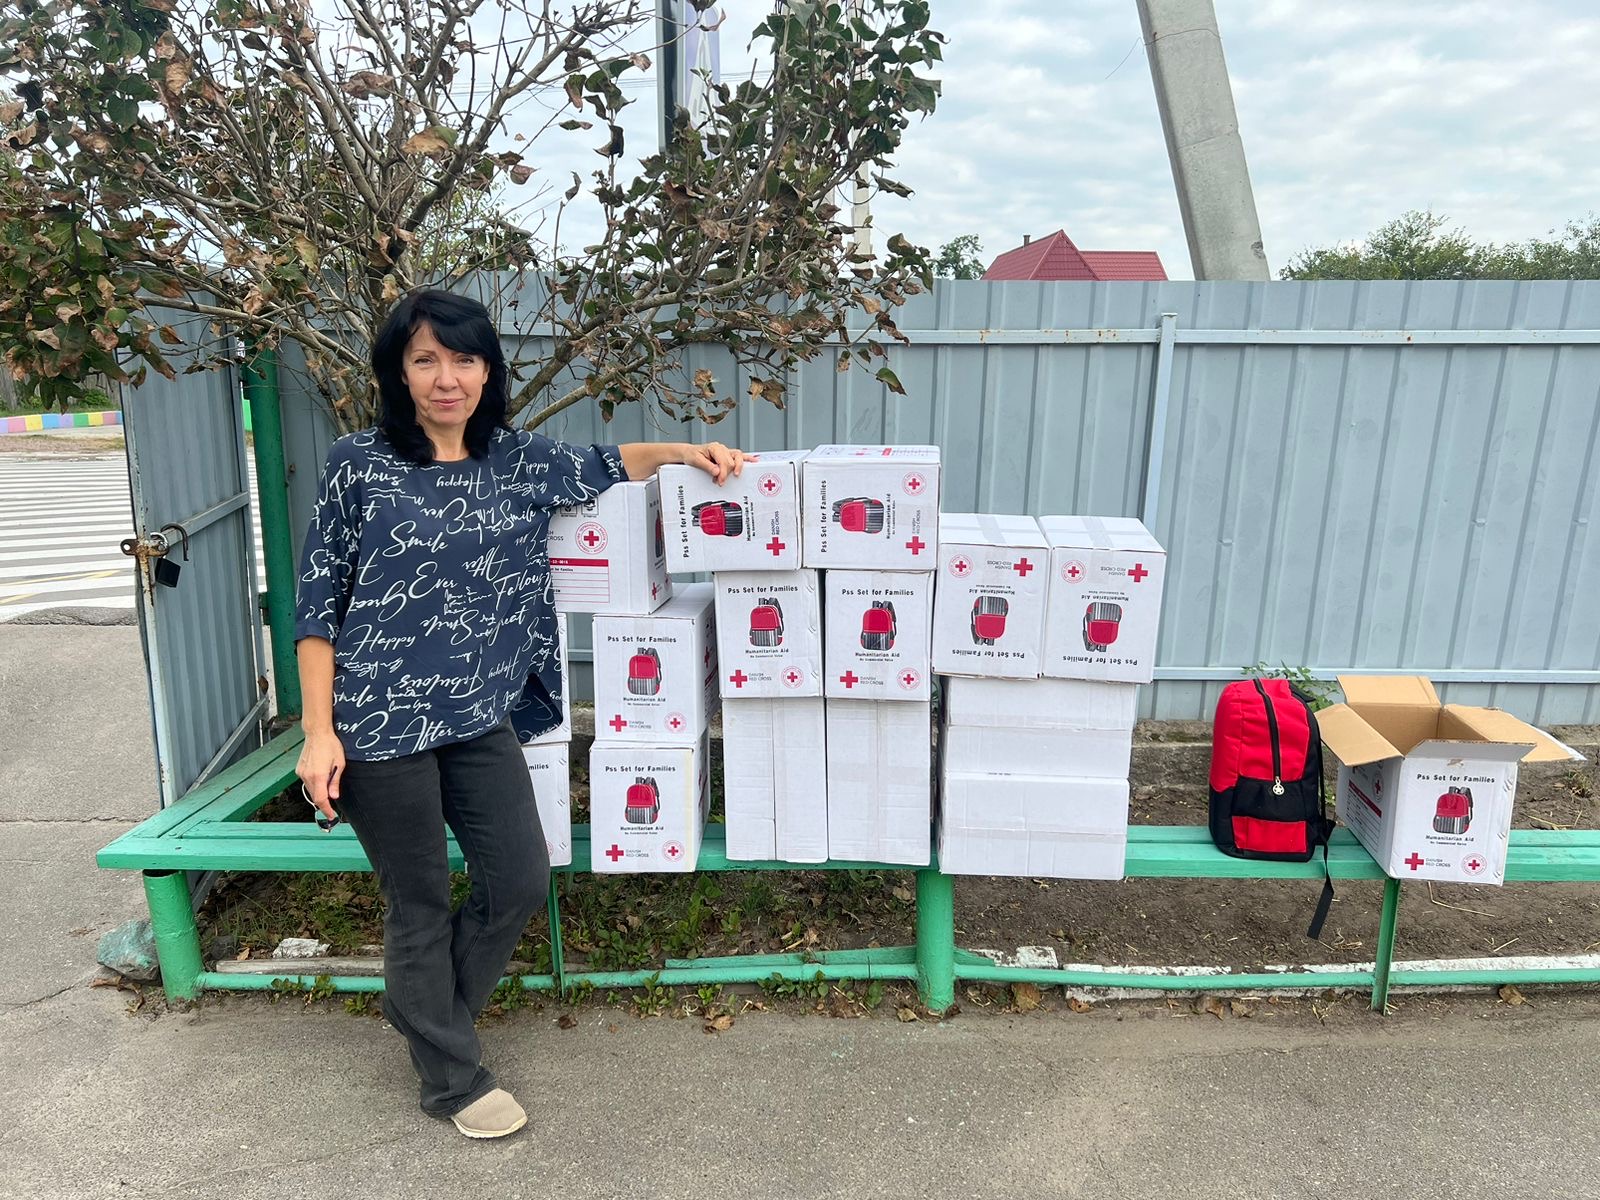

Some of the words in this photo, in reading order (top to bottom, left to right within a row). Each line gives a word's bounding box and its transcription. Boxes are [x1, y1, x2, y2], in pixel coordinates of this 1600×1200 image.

[382, 520, 448, 557] Smile
[408, 561, 458, 599] Ever
[346, 624, 416, 660] Happy
[390, 716, 456, 754] After
